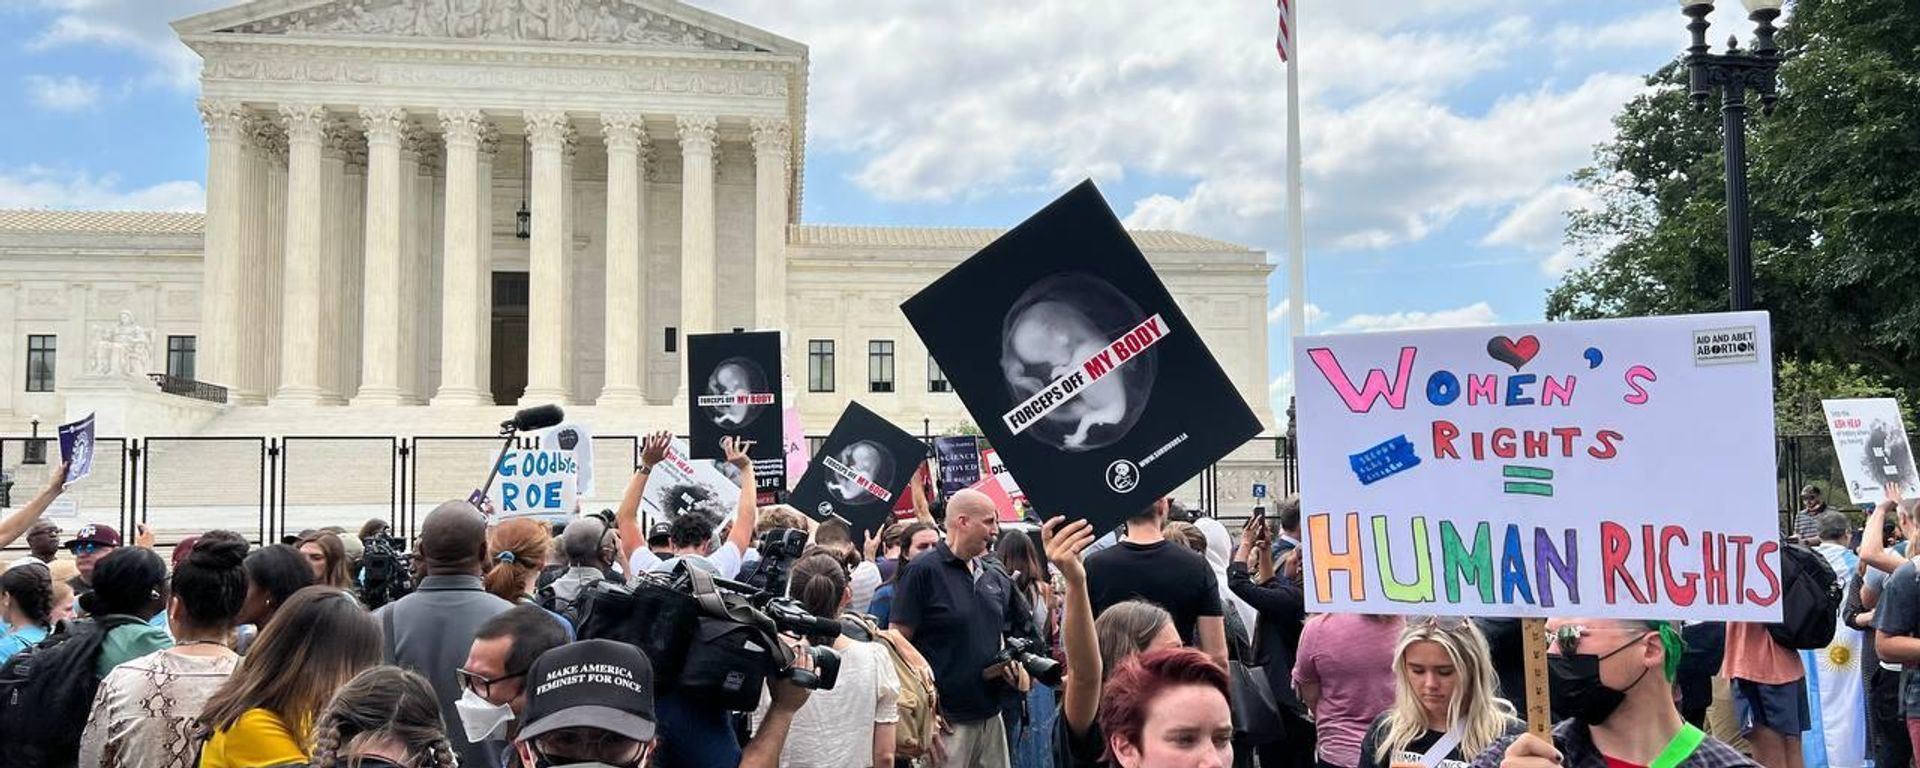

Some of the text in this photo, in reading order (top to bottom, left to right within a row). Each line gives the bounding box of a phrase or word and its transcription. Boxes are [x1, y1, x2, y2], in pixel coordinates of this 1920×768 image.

[1697, 331, 1753, 345] AID AND ABET
[1697, 341, 1755, 356] ABORTION
[1008, 318, 1164, 430] FORCEPS OFF MY BODY
[1306, 346, 1658, 414] WOMEN'S
[736, 395, 749, 405] MY
[750, 394, 772, 404] BODY
[1431, 420, 1625, 461] RIGHTS
[939, 452, 976, 463] SCIENCE
[941, 464, 977, 473] PROVED
[756, 477, 780, 488] LIFE
[856, 475, 869, 489] MY
[869, 482, 890, 501] BODY
[502, 480, 563, 511] ROE
[1306, 511, 1781, 609] HUMAN RIGHTS
[545, 663, 633, 681] MAKE AMERICA
[536, 673, 642, 695] FEMINIST FOR ONCE
